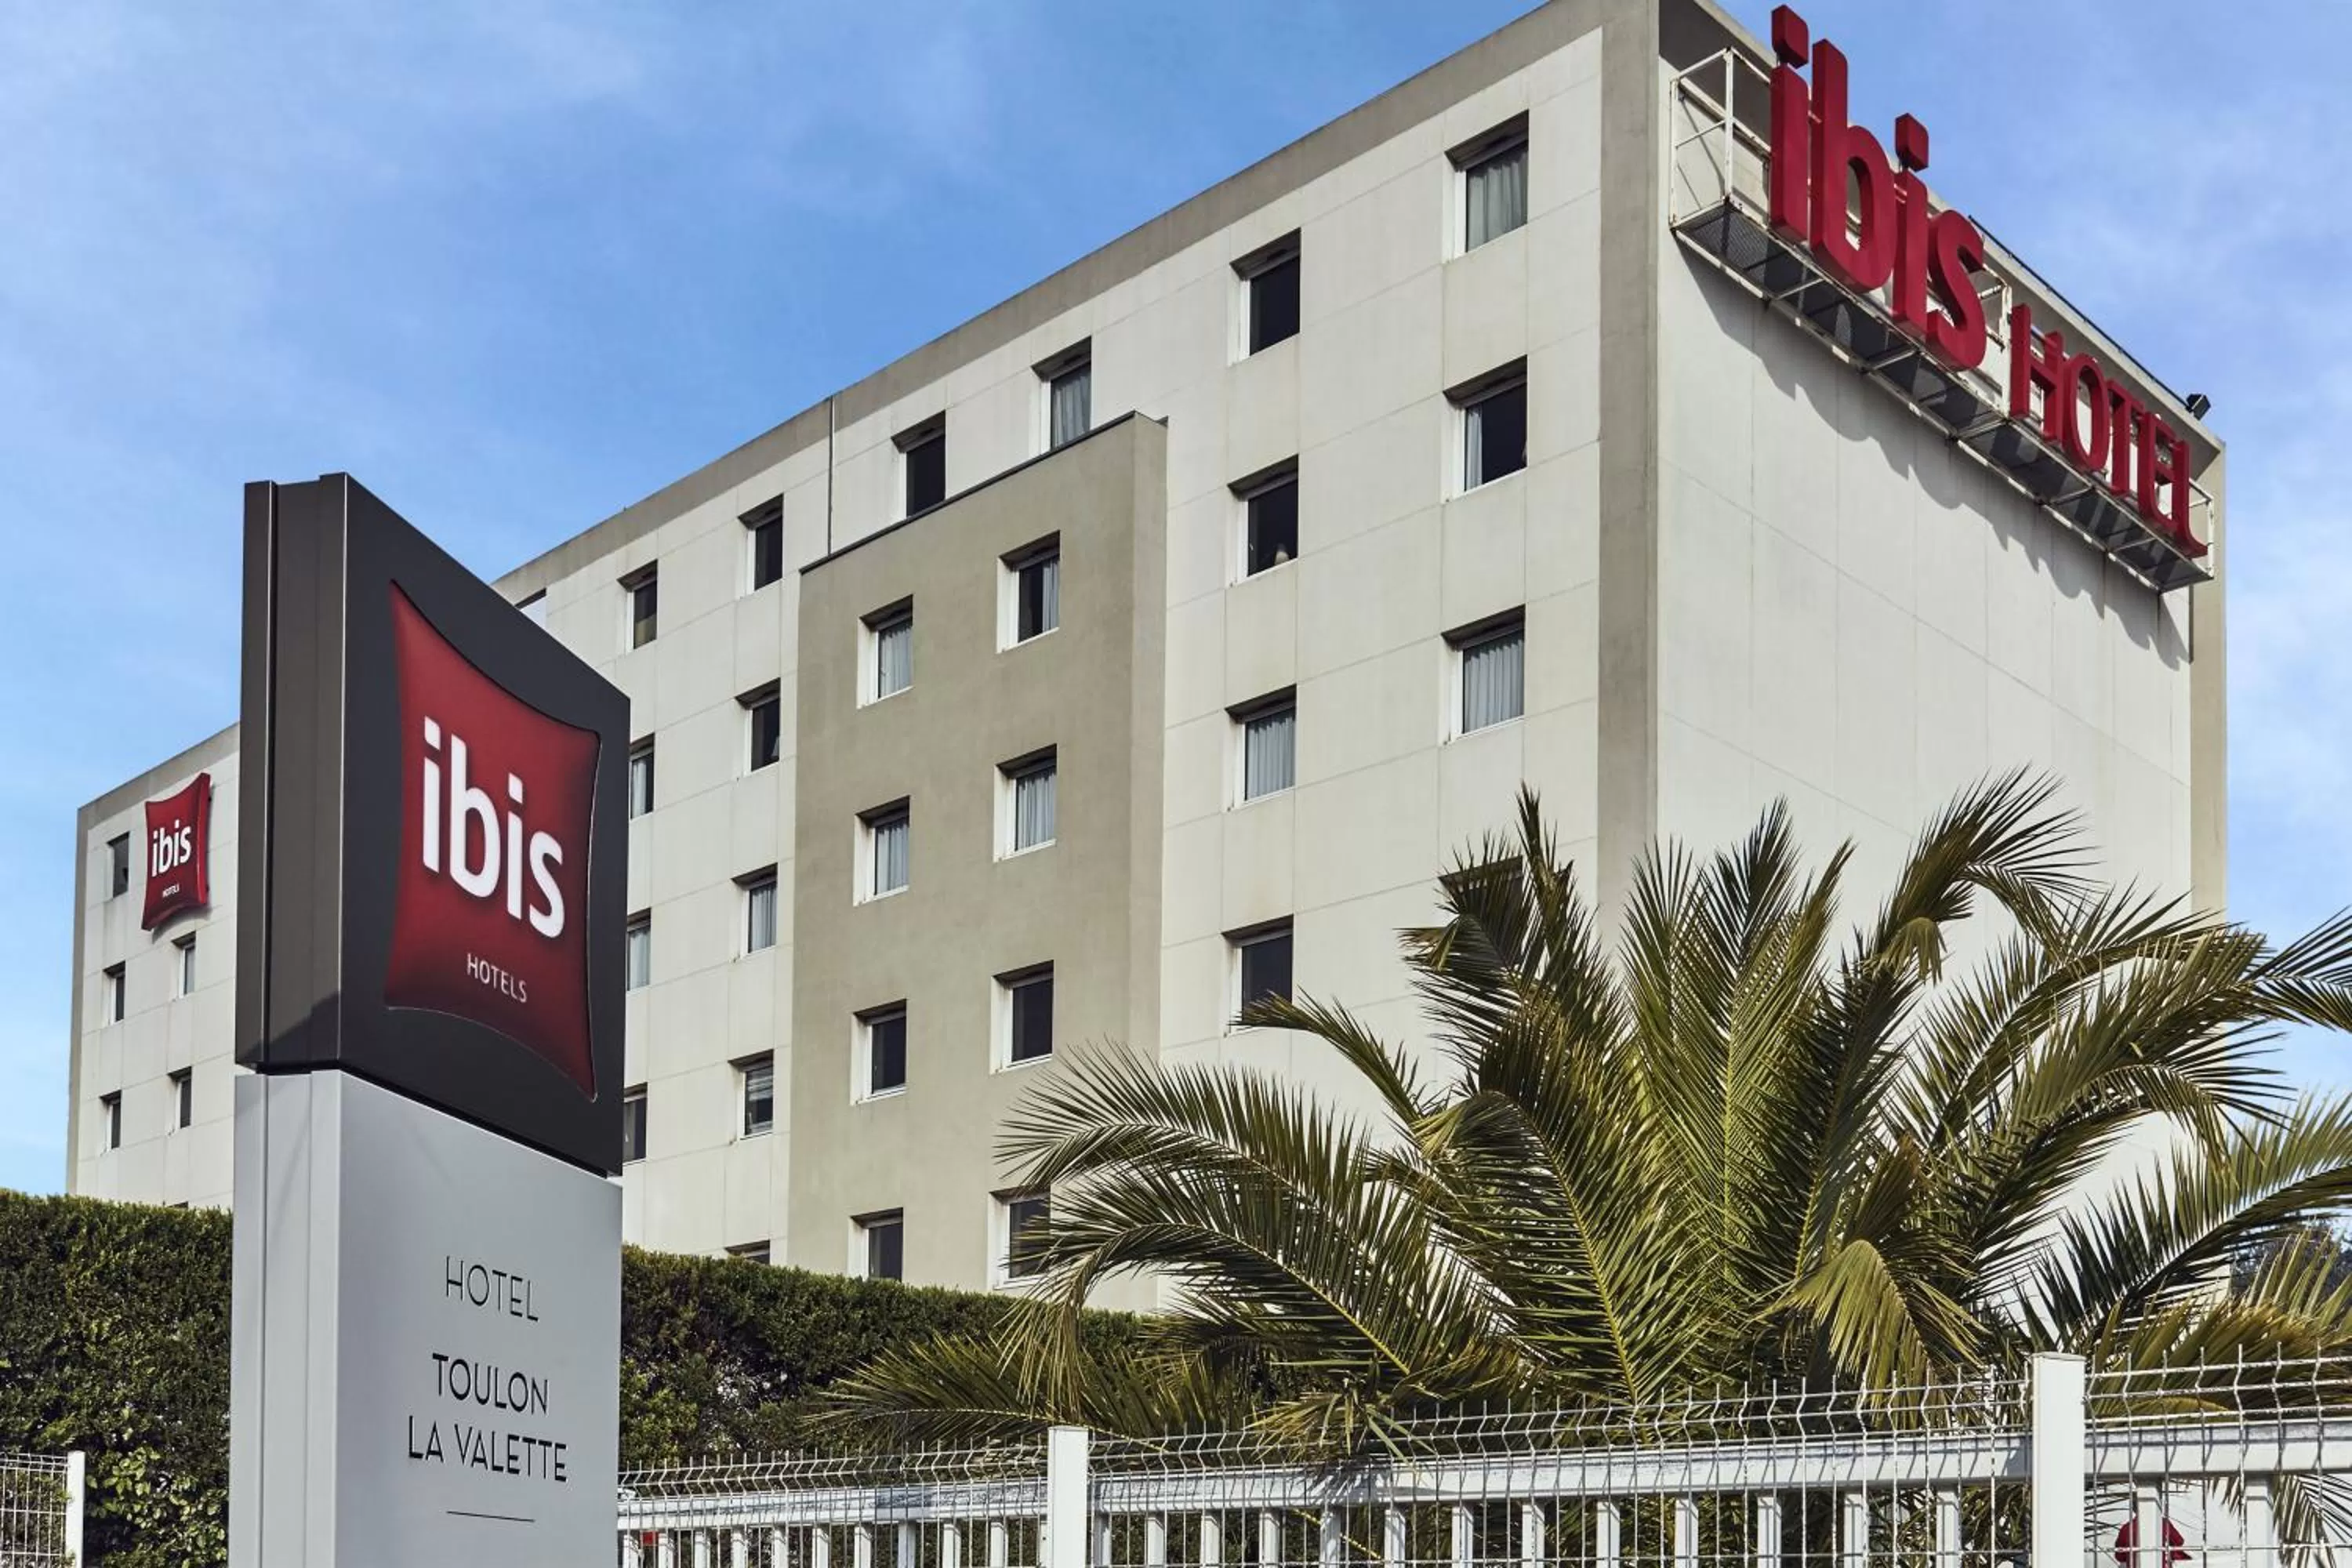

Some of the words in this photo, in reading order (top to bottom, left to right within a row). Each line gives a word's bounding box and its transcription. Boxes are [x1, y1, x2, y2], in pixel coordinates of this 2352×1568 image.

[1770, 5, 1986, 372] ibis
[2010, 303, 2209, 559] HOTEL
[151, 818, 192, 877] ibis
[423, 715, 564, 938] ibis
[466, 952, 528, 1004] HOTELS
[445, 1255, 539, 1322] HOTEL
[432, 1352, 549, 1414] TOULON
[408, 1415, 445, 1463] LA
[454, 1423, 567, 1483] VALETTE
